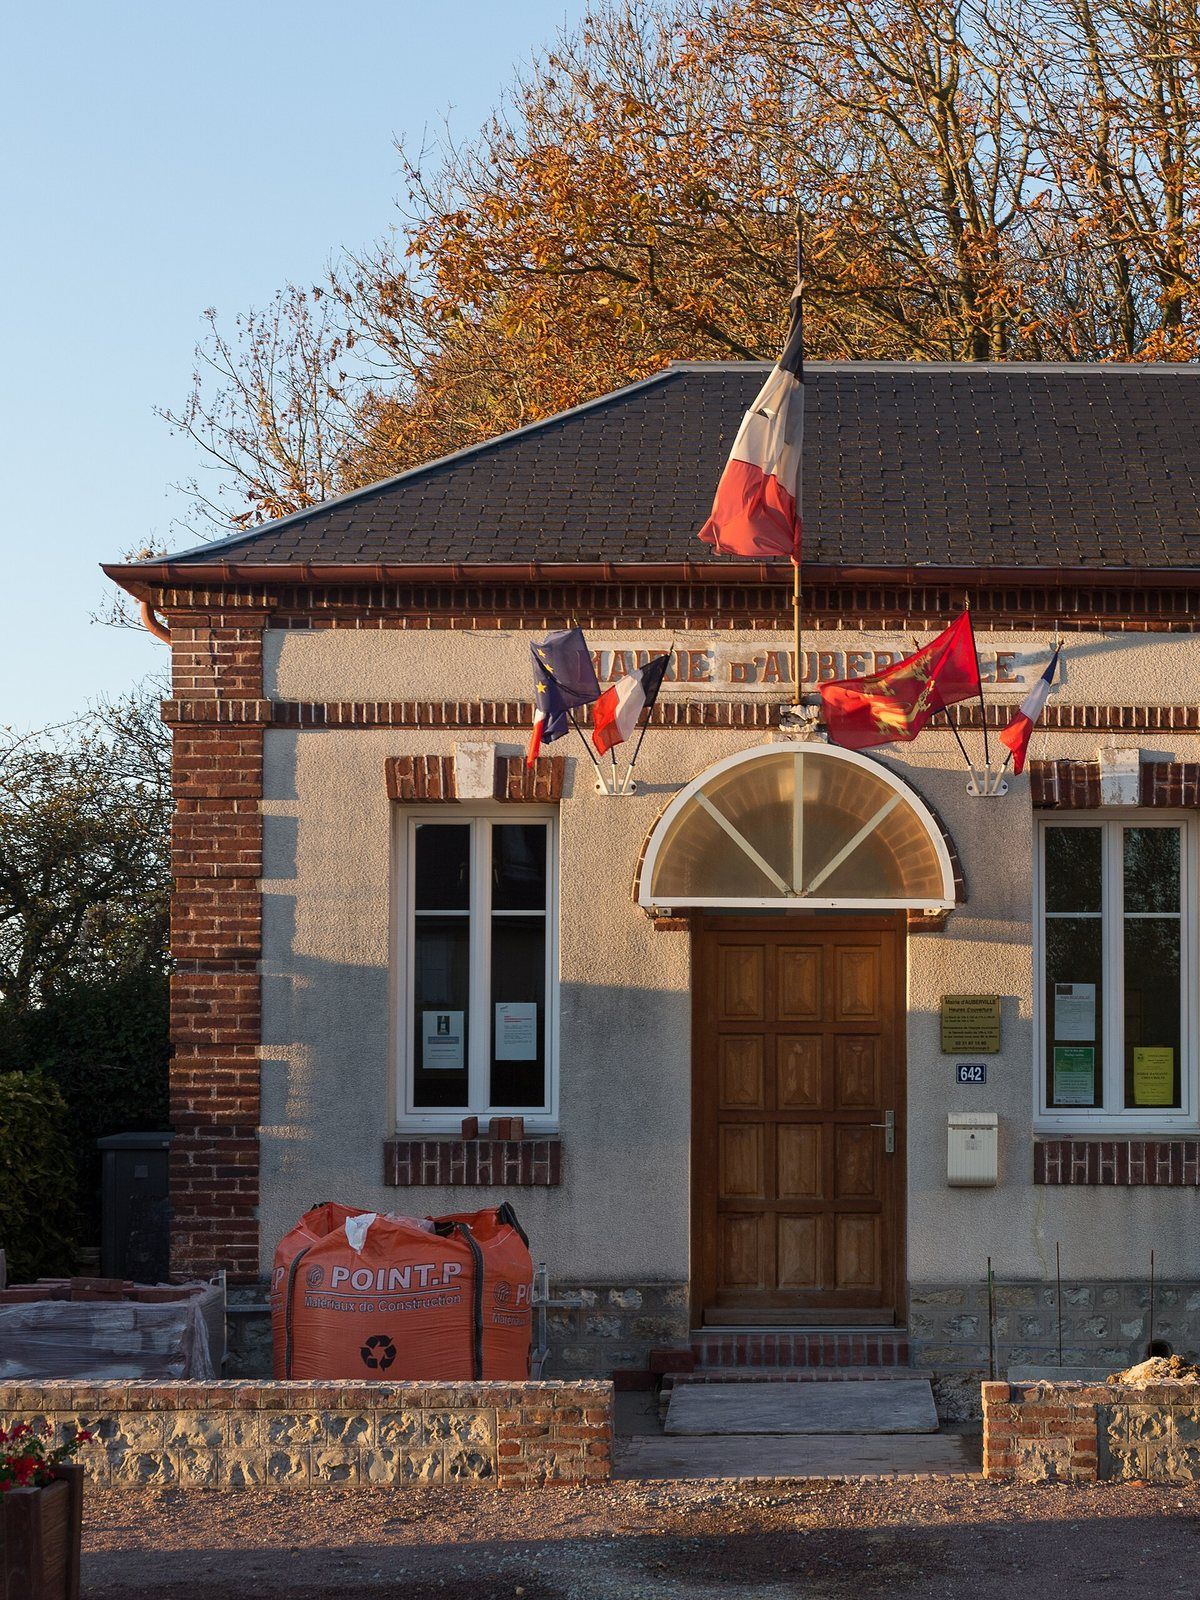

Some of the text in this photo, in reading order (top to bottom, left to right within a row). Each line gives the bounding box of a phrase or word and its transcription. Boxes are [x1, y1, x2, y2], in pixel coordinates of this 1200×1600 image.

[960, 1066, 982, 1081] 642
[330, 1262, 462, 1291] POINT.P
[304, 1294, 463, 1312] Matériaux de Construction
